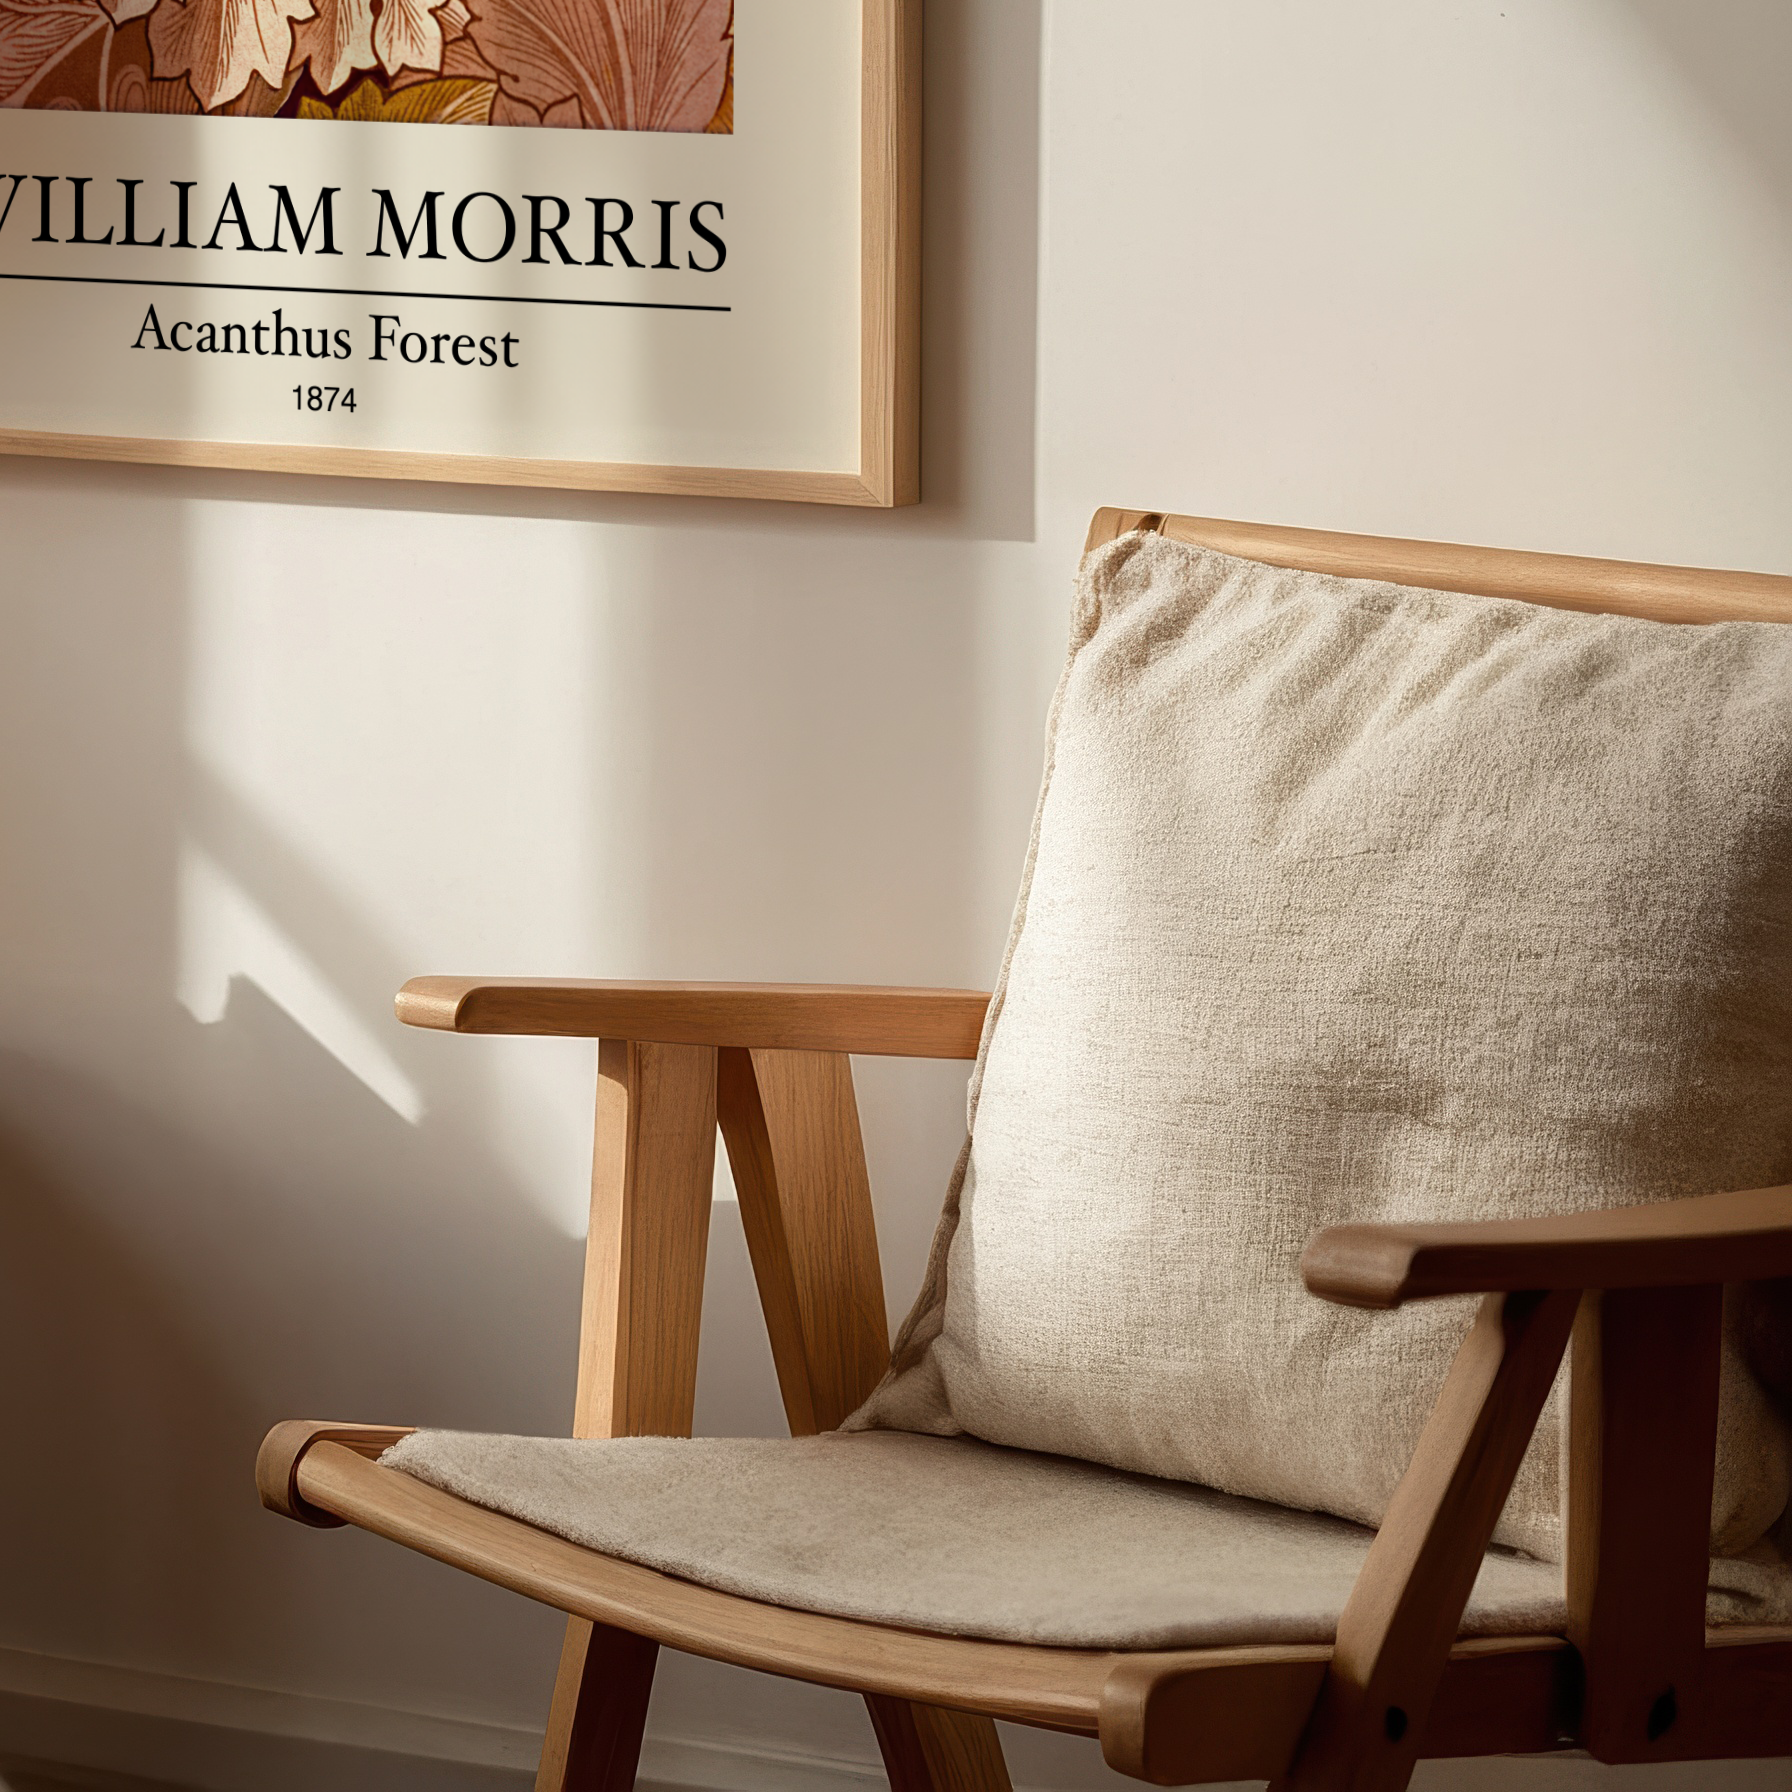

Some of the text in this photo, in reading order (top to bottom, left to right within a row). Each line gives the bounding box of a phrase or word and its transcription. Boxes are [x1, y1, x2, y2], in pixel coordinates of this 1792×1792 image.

[365, 188, 728, 273] MORRIS
[130, 303, 520, 368] Acanthus Forest
[292, 384, 357, 413] 1874
